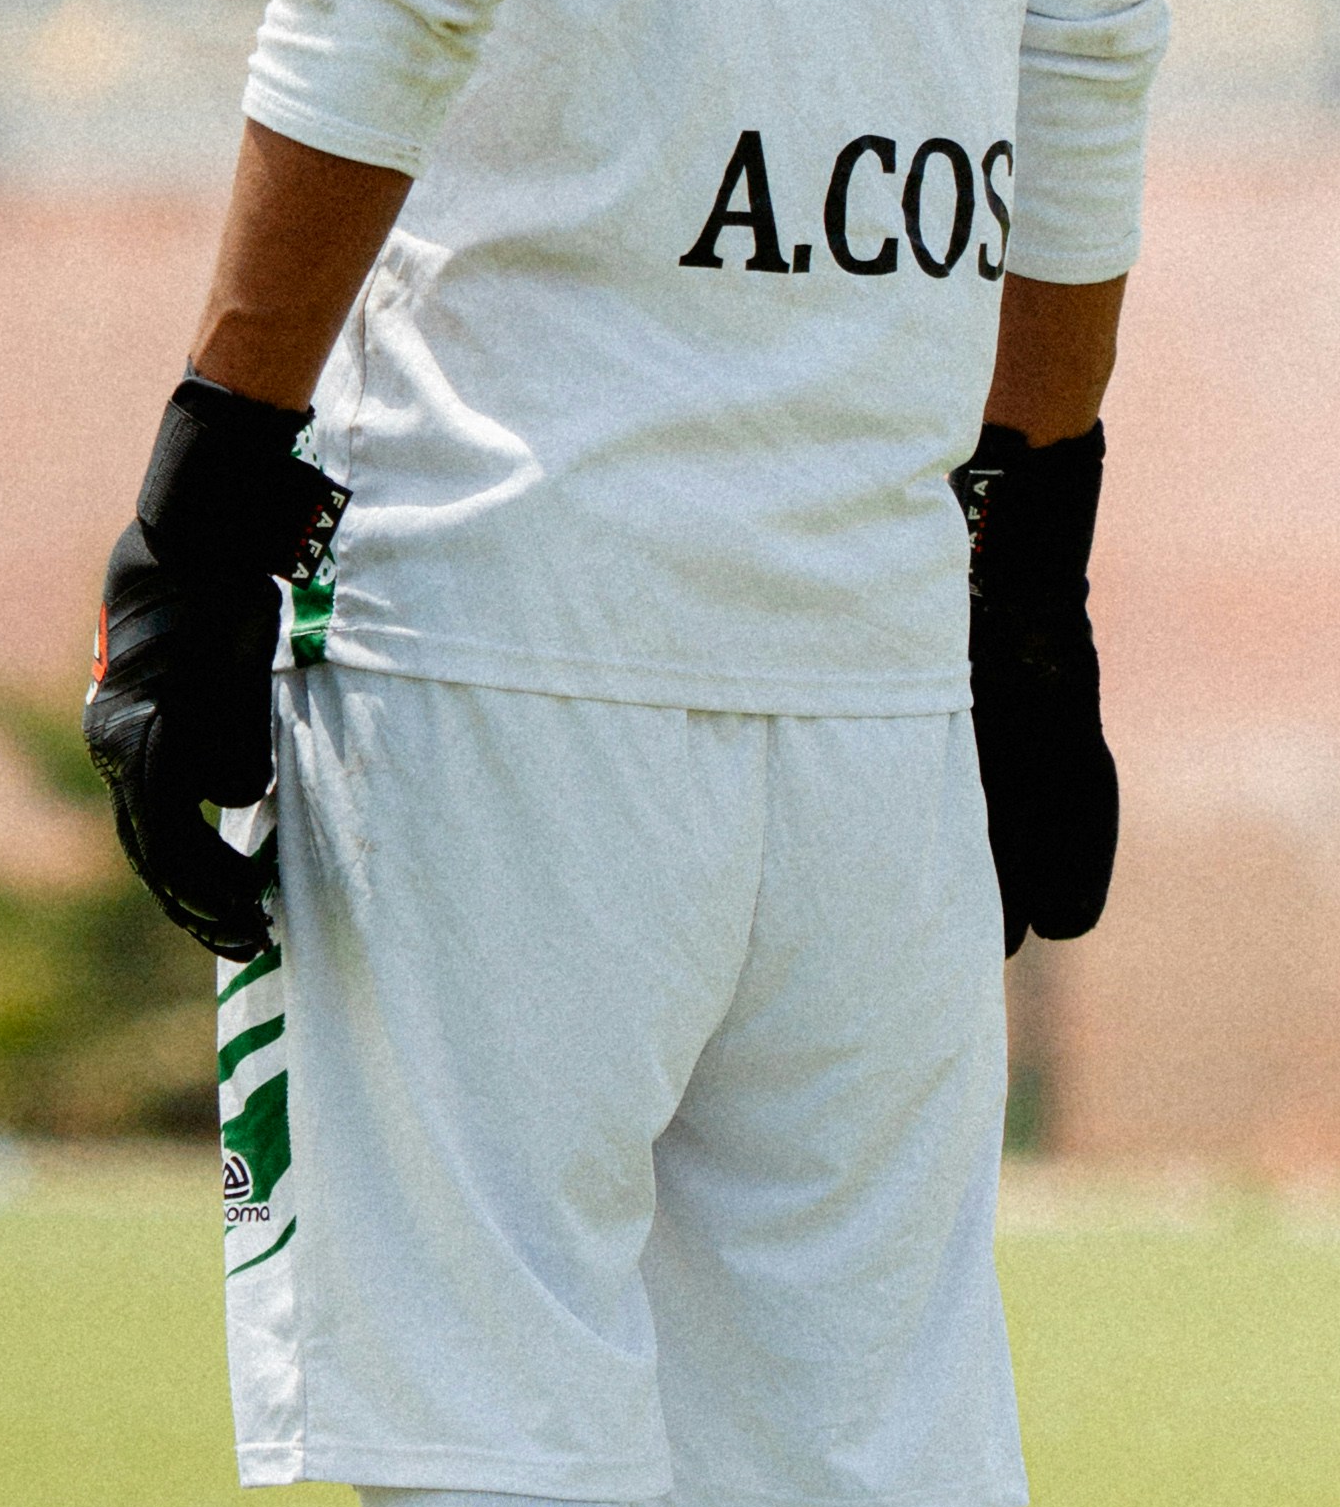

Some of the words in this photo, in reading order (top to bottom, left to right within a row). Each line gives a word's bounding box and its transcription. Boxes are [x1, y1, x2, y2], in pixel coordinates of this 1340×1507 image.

[678, 130, 1013, 282] A.COS
[291, 490, 346, 579] FAFA
[967, 480, 989, 574] AFA
[223, 1205, 270, 1223] oma
